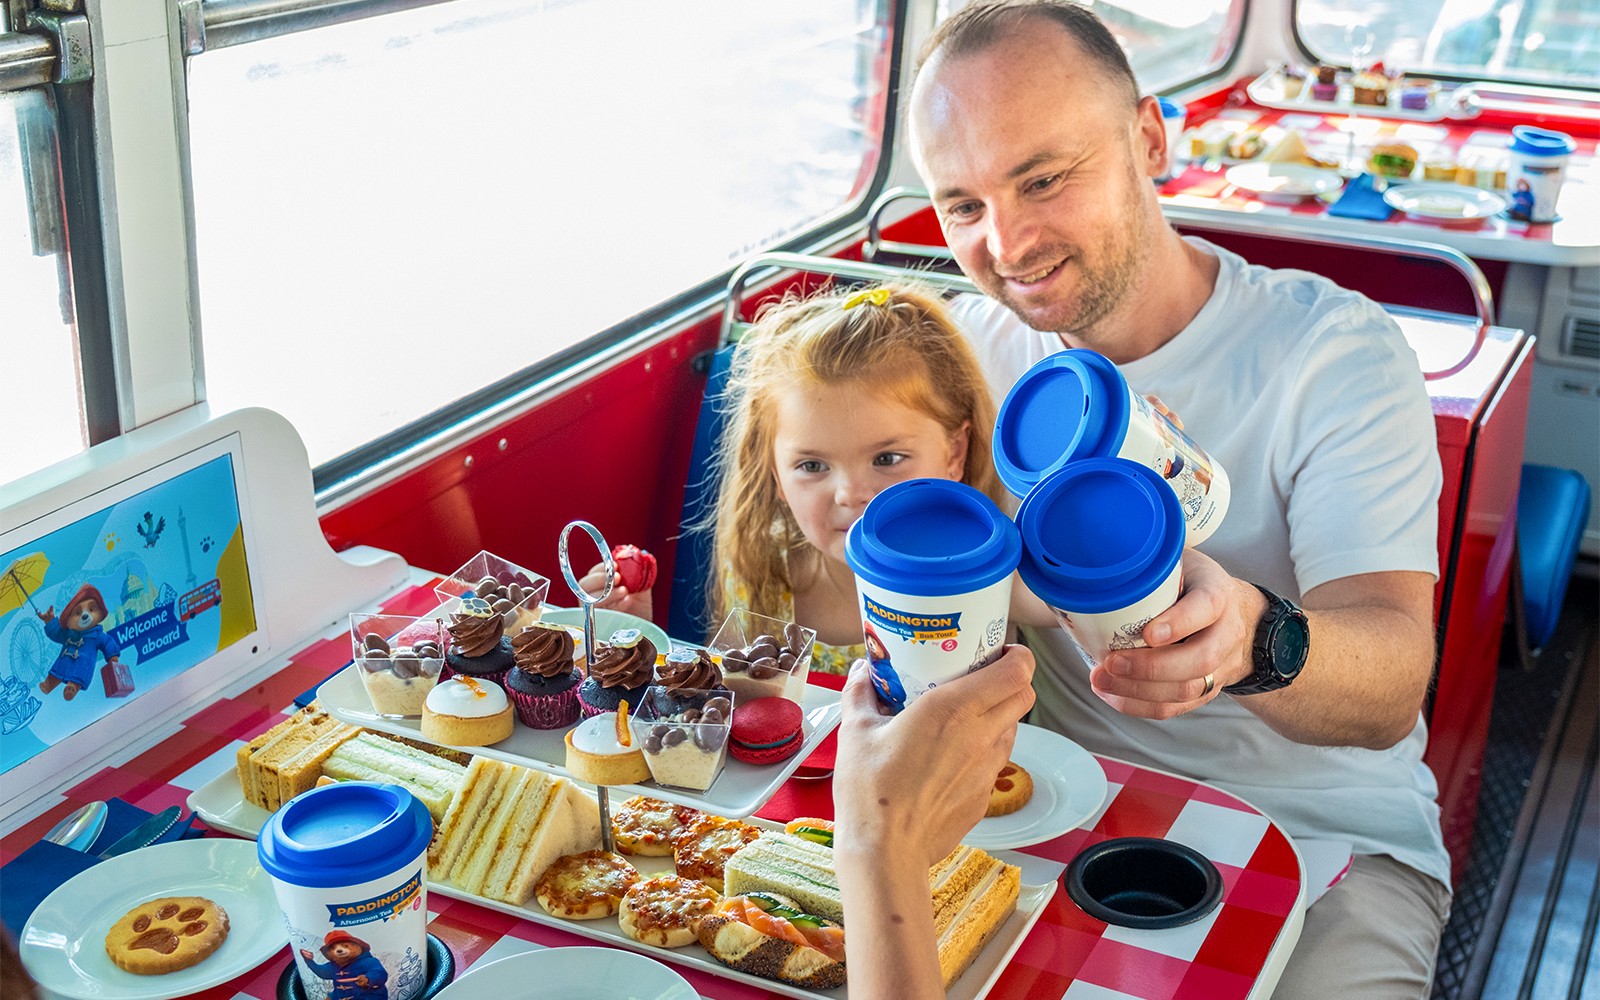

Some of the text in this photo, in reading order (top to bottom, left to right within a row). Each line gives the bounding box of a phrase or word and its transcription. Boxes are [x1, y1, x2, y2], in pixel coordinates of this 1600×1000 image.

[116, 610, 168, 645] Welcome
[869, 614, 912, 636] Afternoon Tea
[141, 624, 180, 655] aboard
[340, 909, 392, 926] Afternoon Tea
